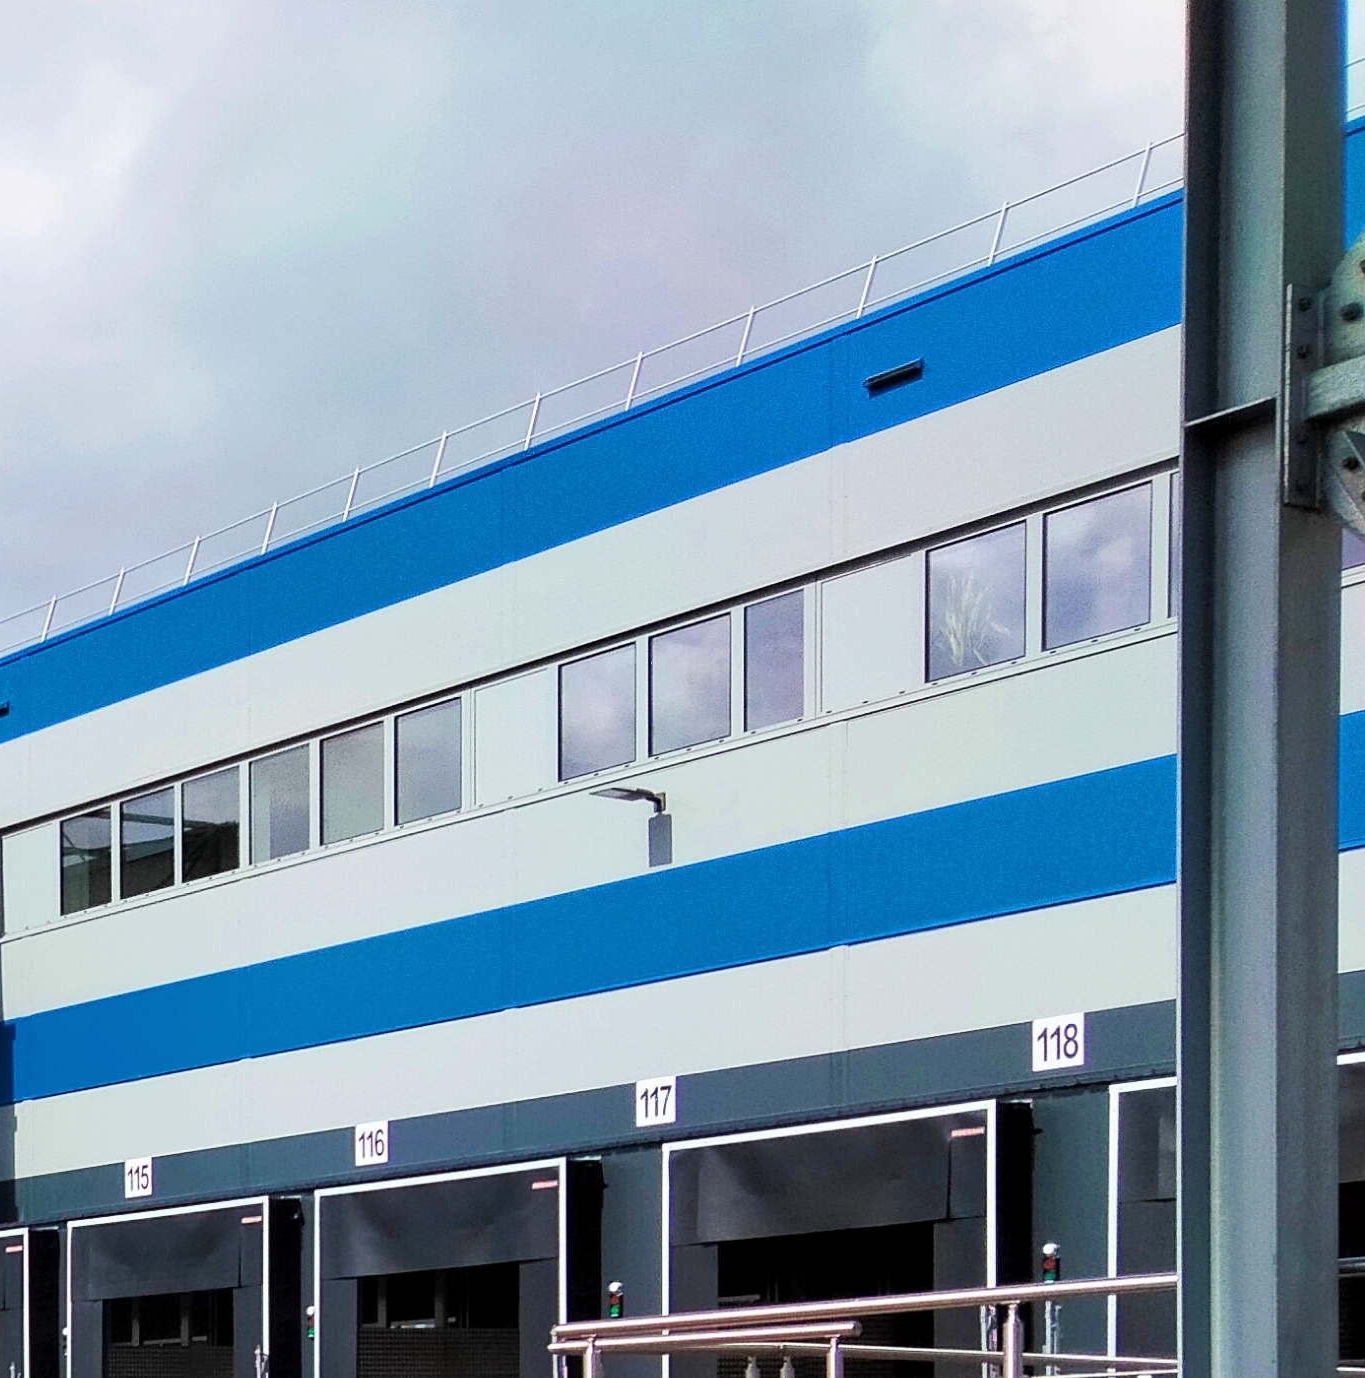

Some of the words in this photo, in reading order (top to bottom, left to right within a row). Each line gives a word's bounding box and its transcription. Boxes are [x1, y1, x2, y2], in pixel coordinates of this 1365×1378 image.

[1037, 1023, 1078, 1062] 118
[640, 1084, 672, 1118] 117
[358, 1129, 384, 1158] 116
[127, 1164, 149, 1191] 115
